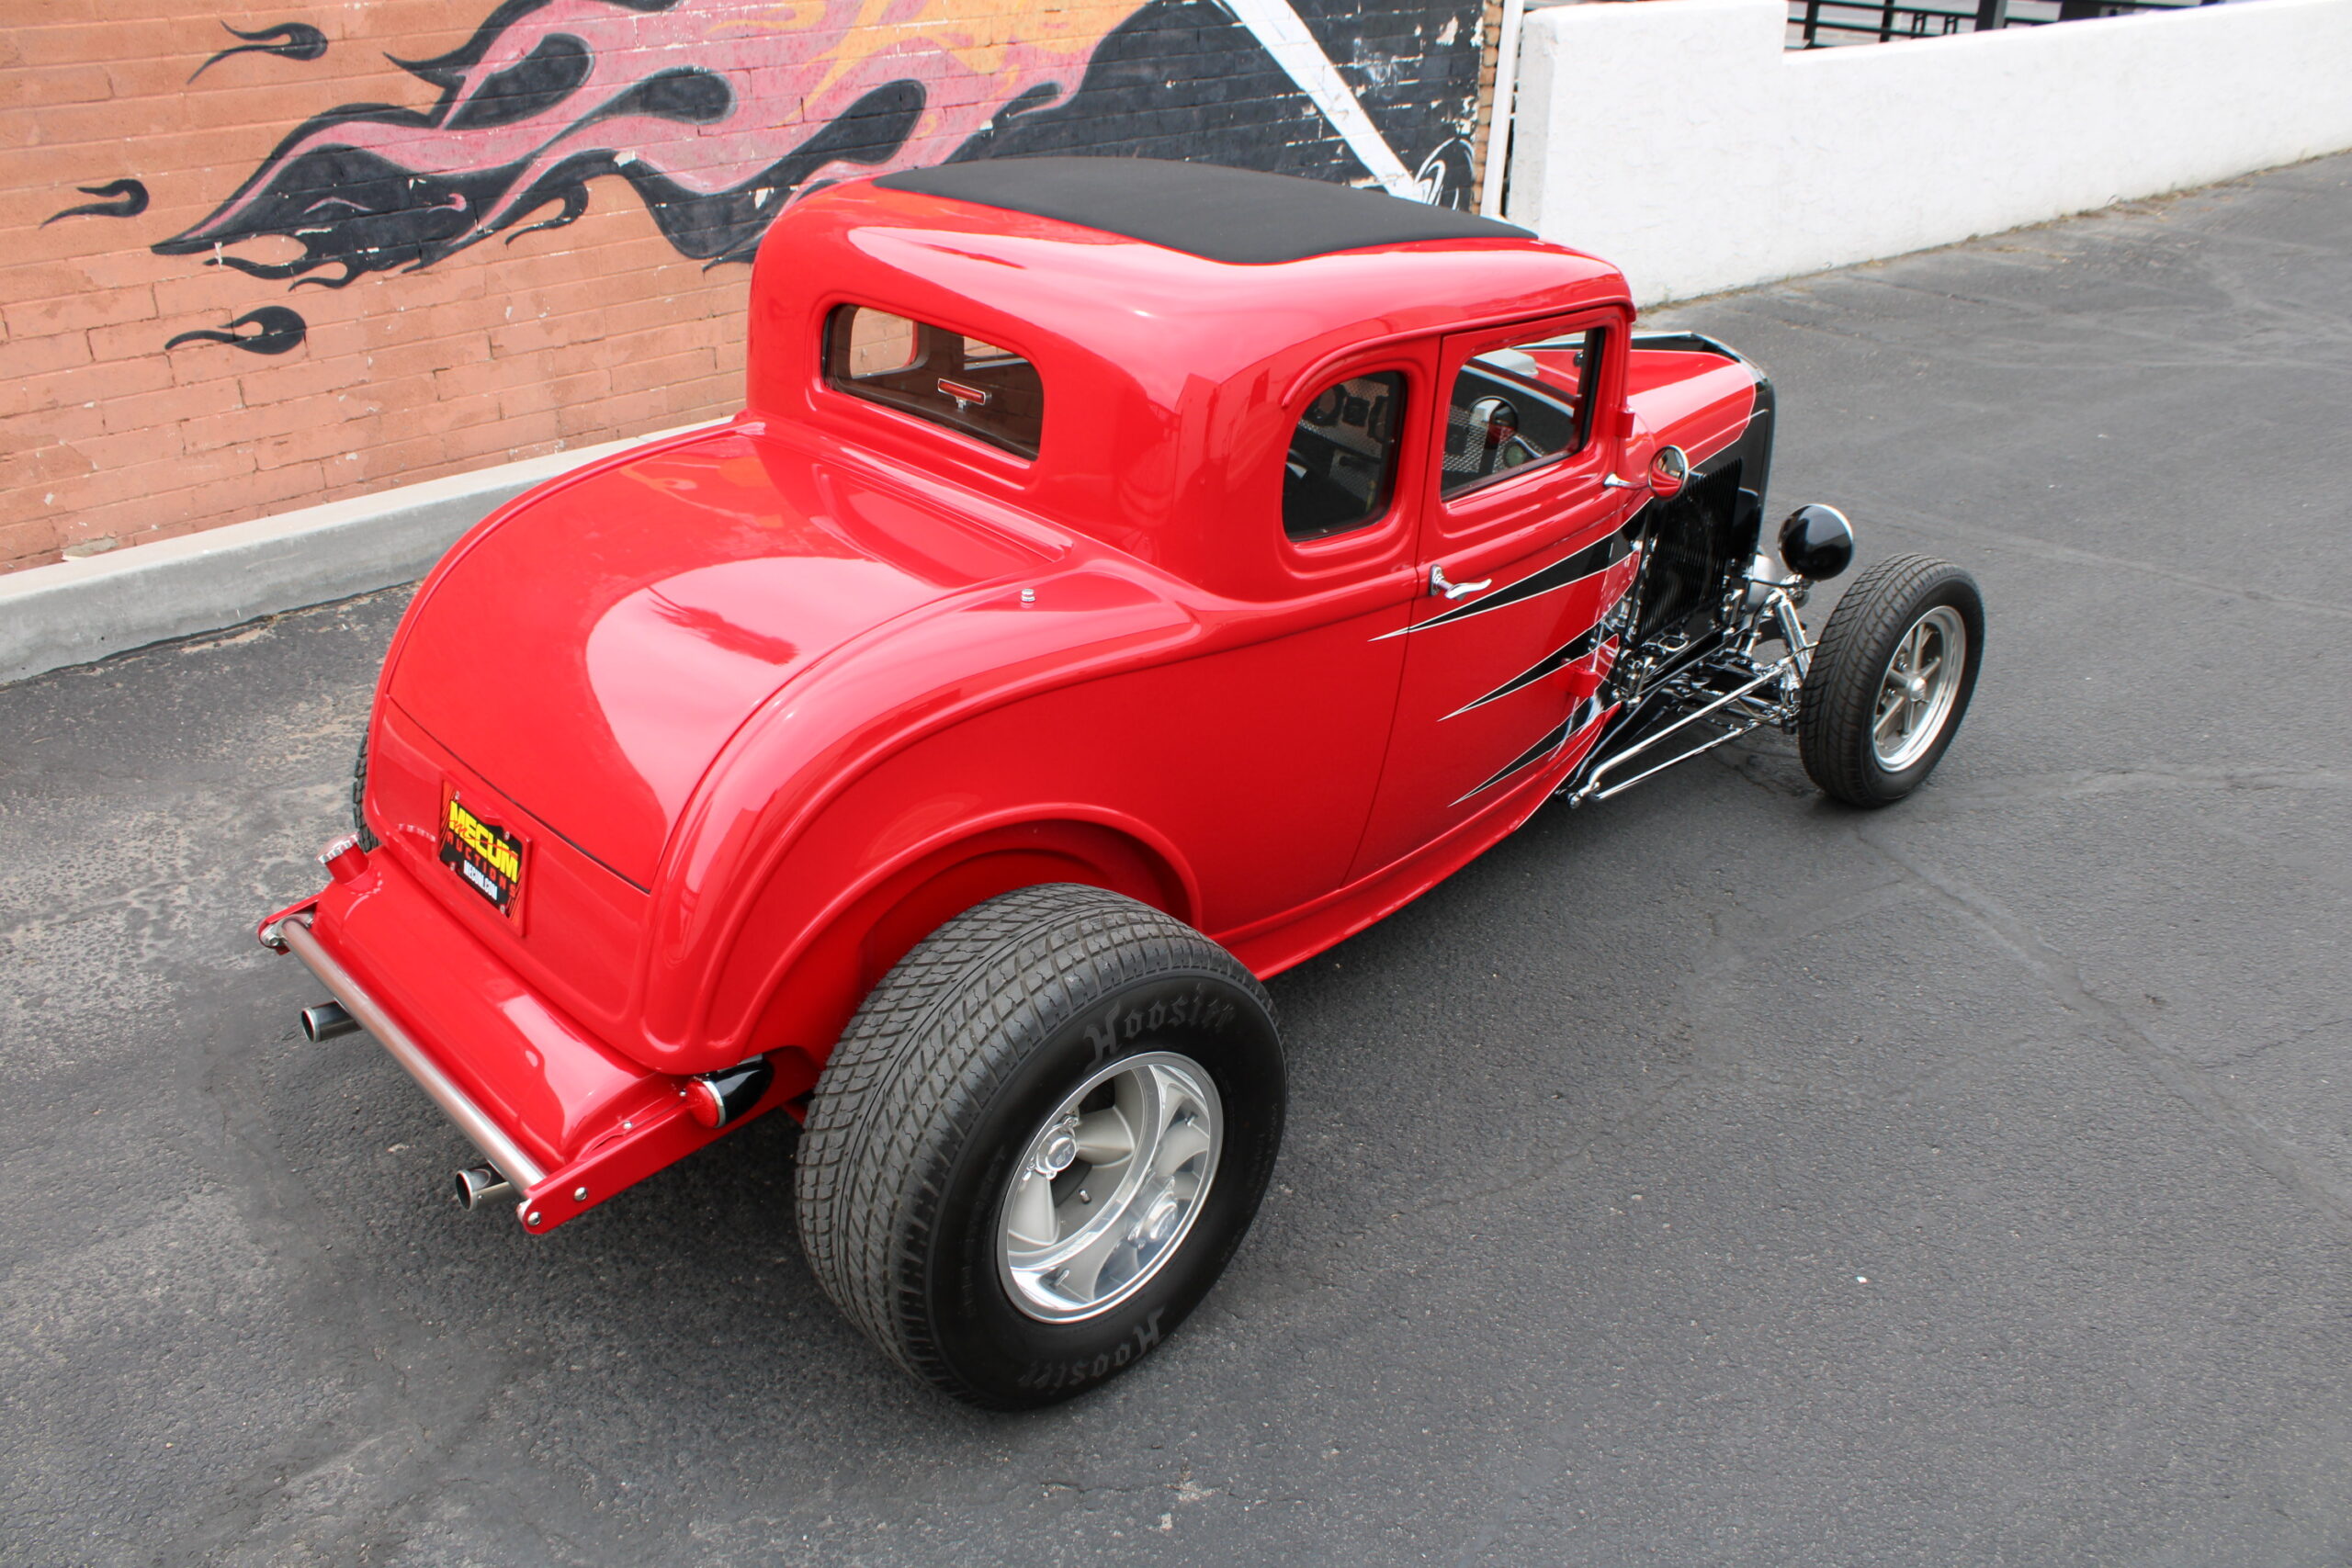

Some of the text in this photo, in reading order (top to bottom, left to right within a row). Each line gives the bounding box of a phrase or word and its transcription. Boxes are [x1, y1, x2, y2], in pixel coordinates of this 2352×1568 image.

[447, 830, 516, 898] AUCTIONS
[448, 800, 519, 883] MECUM
[1083, 982, 1235, 1074] Hoosier
[1017, 1305, 1168, 1395] Hoosier
